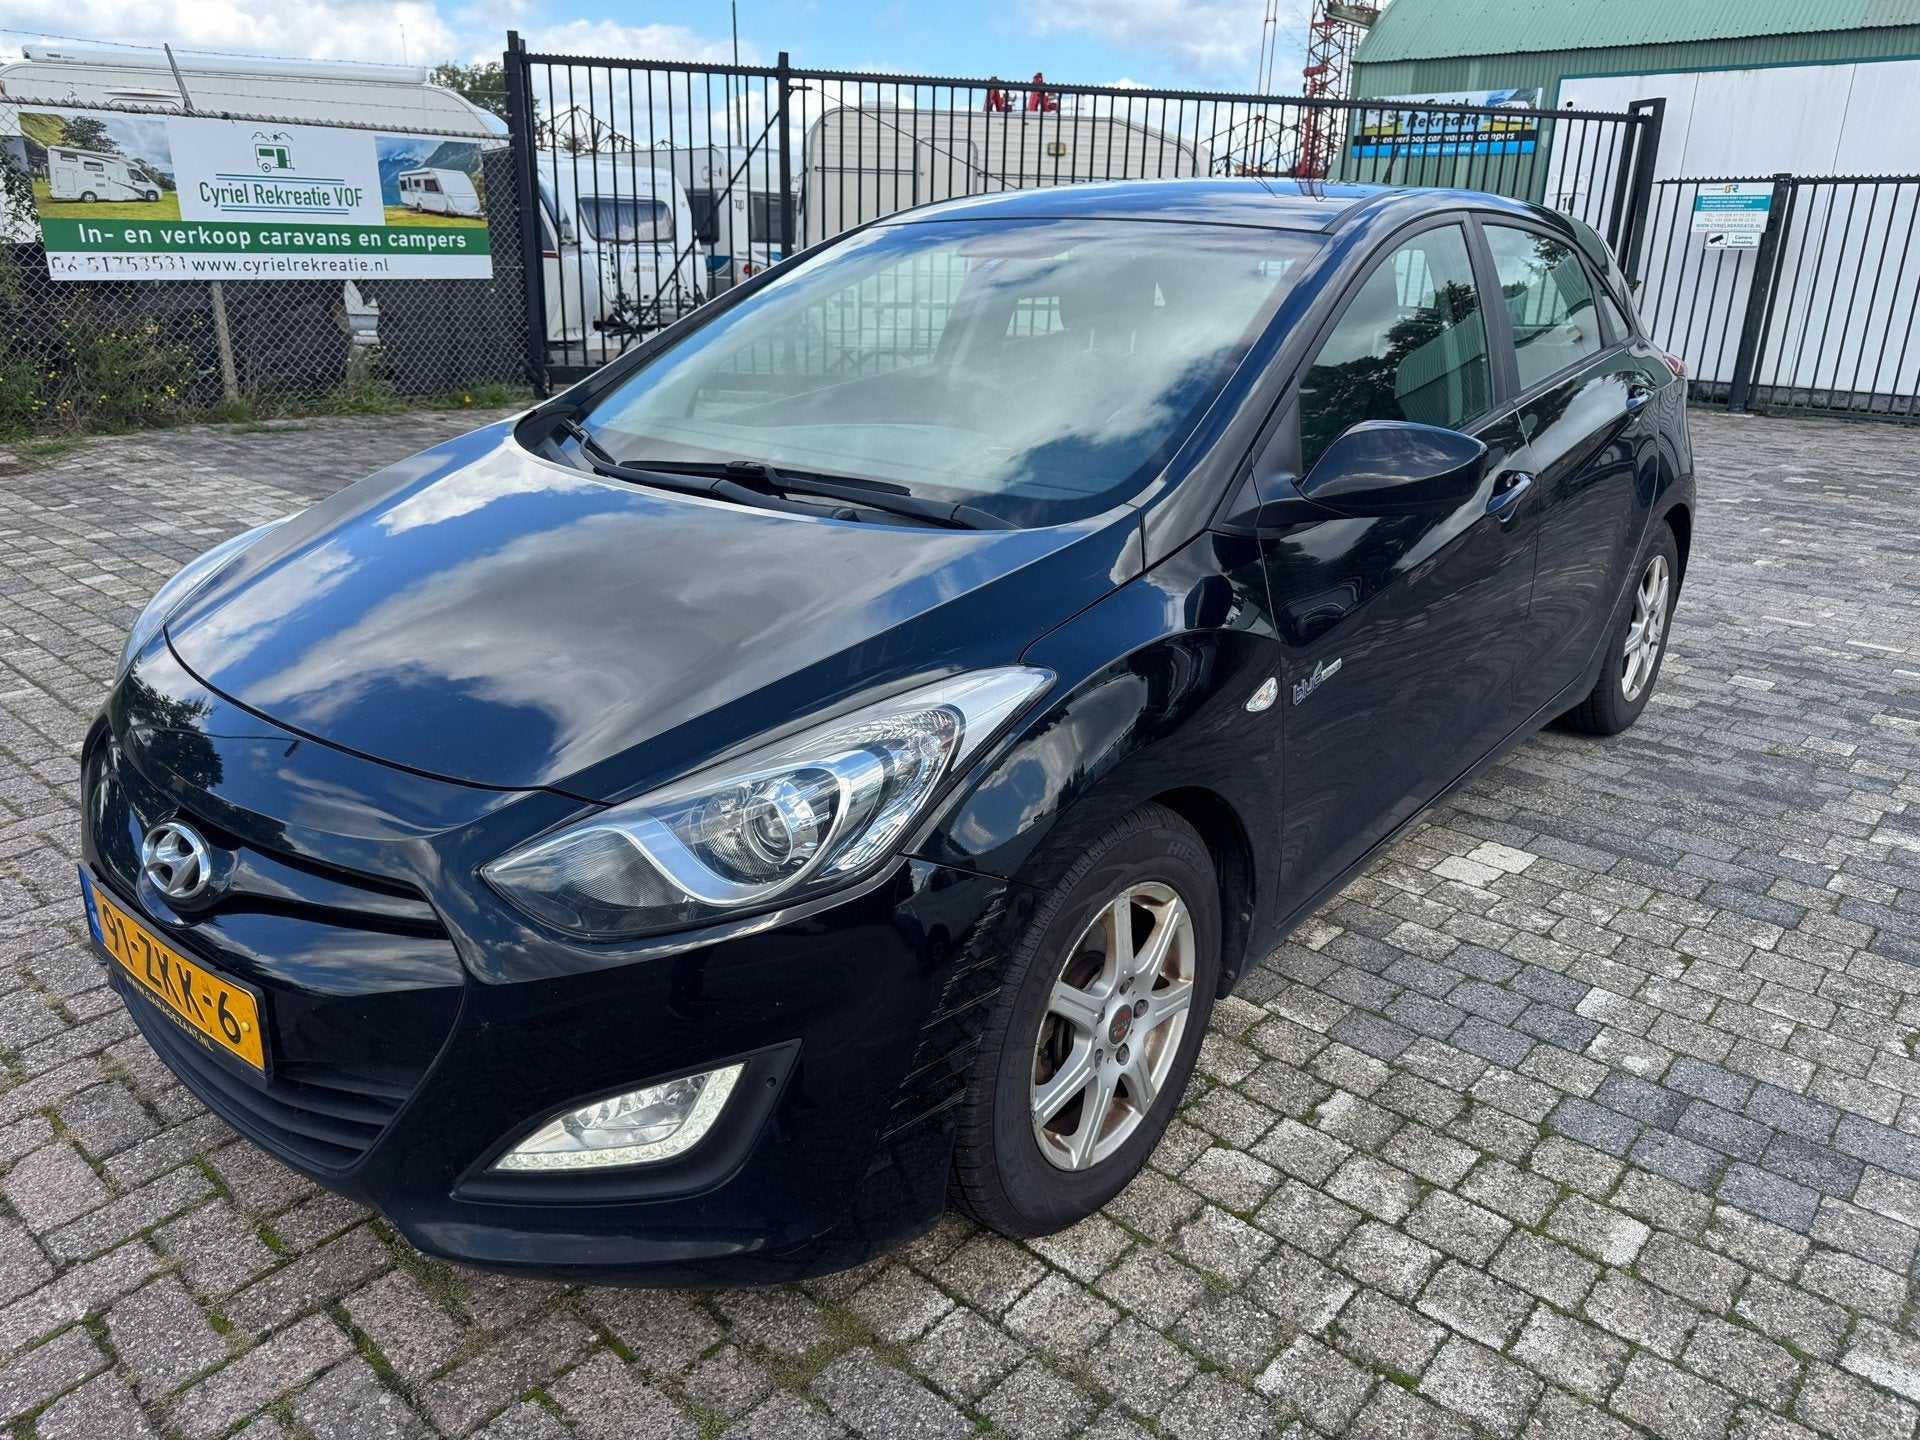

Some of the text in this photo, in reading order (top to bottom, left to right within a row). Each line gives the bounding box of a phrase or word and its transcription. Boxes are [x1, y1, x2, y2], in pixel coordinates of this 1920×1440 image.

[199, 181, 363, 208] Cyriel Rekreatie VOF
[78, 223, 467, 251] In- en verkoop caravans en campers
[192, 257, 390, 275] www.cyrielrekreatie.nl
[102, 903, 242, 1045] 91-ZKK-6
[124, 971, 214, 1052] WWW.GARAGEZAAT.NL
